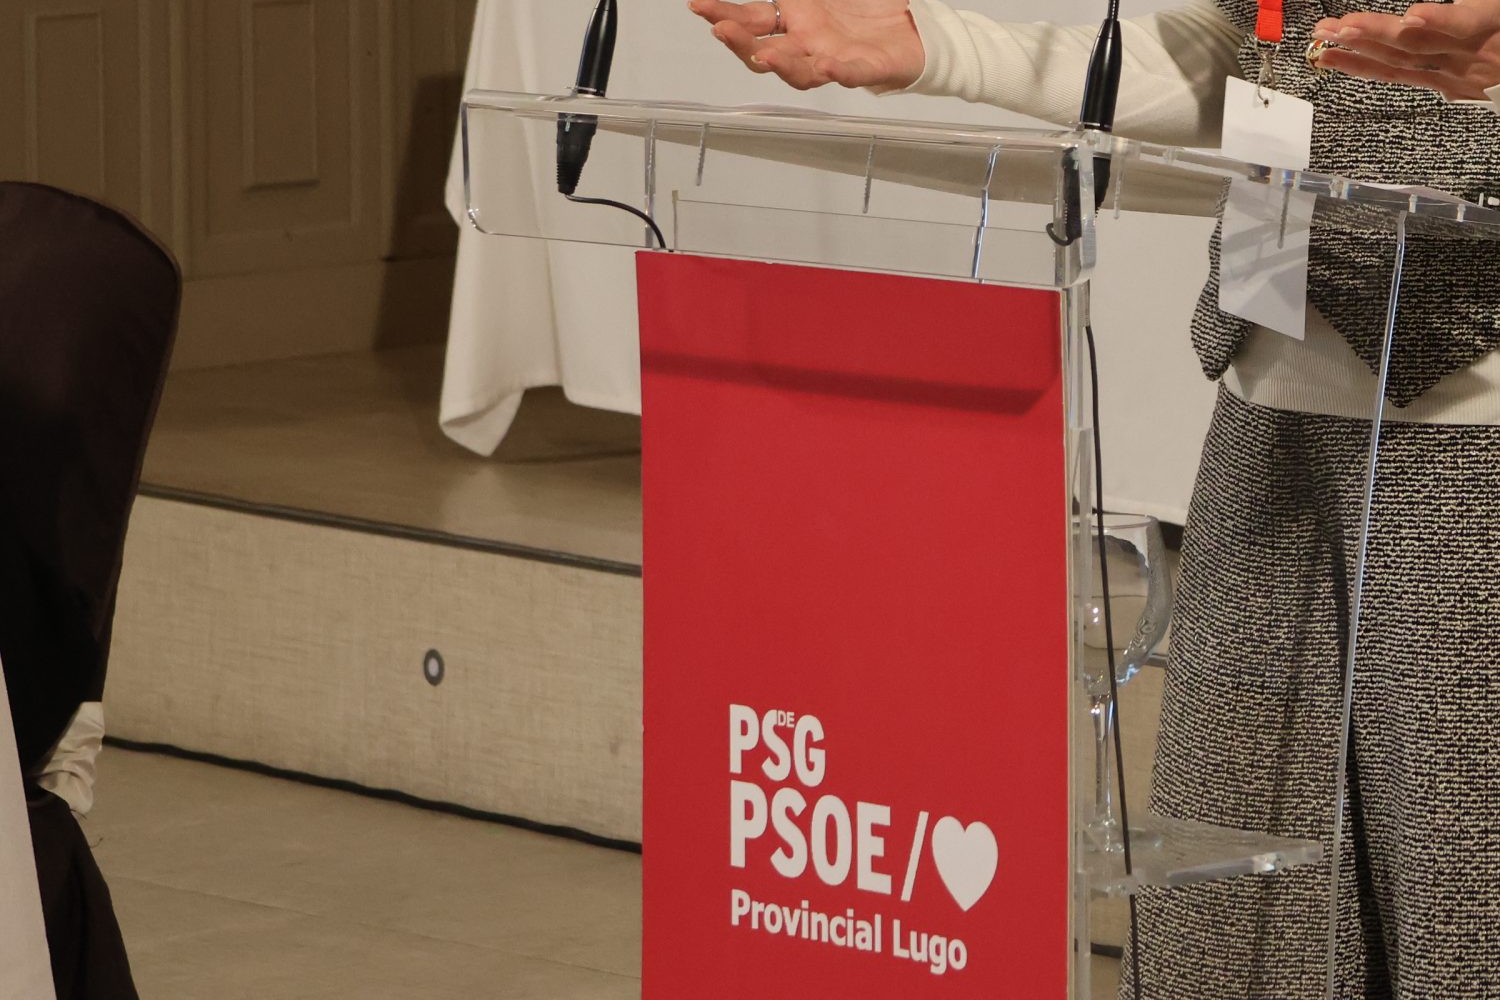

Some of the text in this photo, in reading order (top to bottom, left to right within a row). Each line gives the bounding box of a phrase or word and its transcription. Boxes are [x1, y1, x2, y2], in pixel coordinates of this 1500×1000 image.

[729, 703, 826, 788] PSG DE
[731, 888, 968, 976] Provincial Lugo
